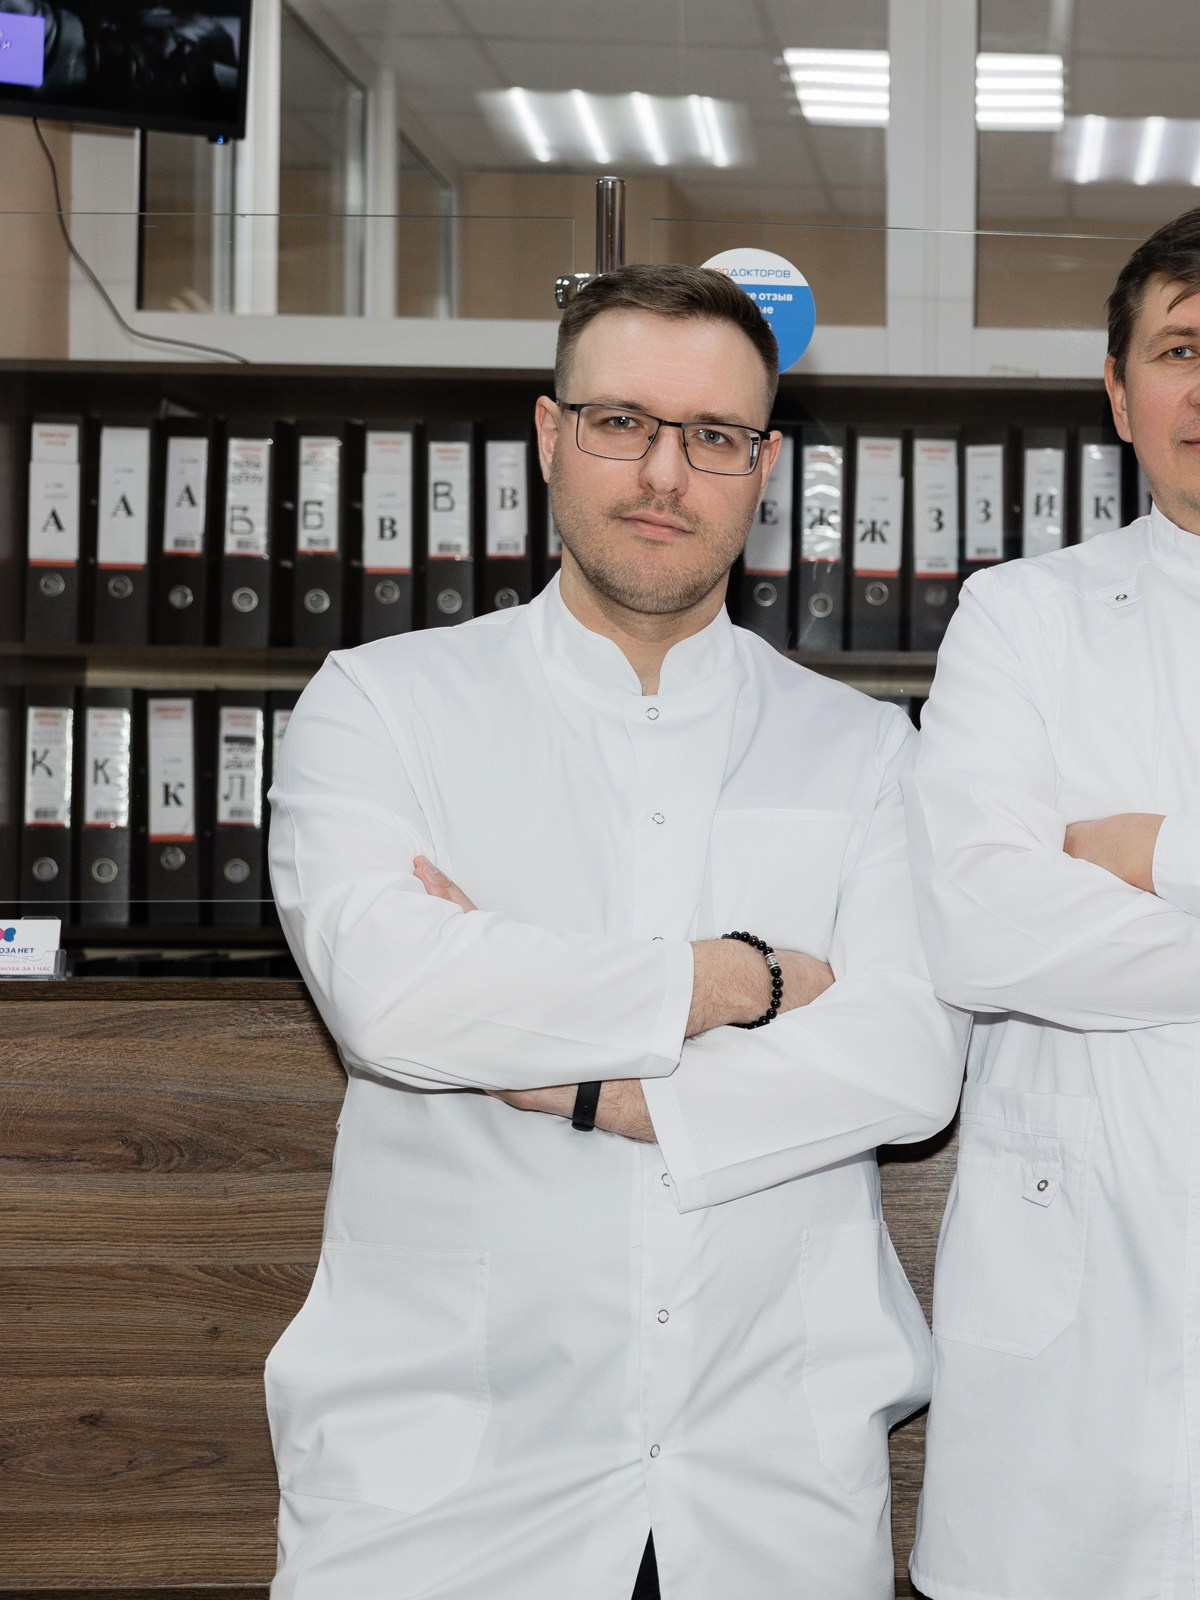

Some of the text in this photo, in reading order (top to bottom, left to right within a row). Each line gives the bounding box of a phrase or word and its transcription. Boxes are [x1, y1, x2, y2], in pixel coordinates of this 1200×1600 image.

[706, 267, 791, 278] ОДОКТОРОВ
[758, 292, 793, 302] отзыв
[111, 493, 134, 517] А
[176, 483, 197, 507] А
[432, 481, 455, 512] В
[499, 486, 518, 510] В
[1033, 493, 1056, 517] И
[1094, 495, 1115, 519] К
[42, 508, 65, 532] А
[229, 504, 255, 535] Б
[303, 500, 324, 530] Б
[759, 501, 778, 525] Е
[378, 516, 398, 541] В
[856, 519, 891, 544] Ж
[31, 748, 53, 778] К
[93, 757, 111, 785] К
[162, 782, 186, 807] К
